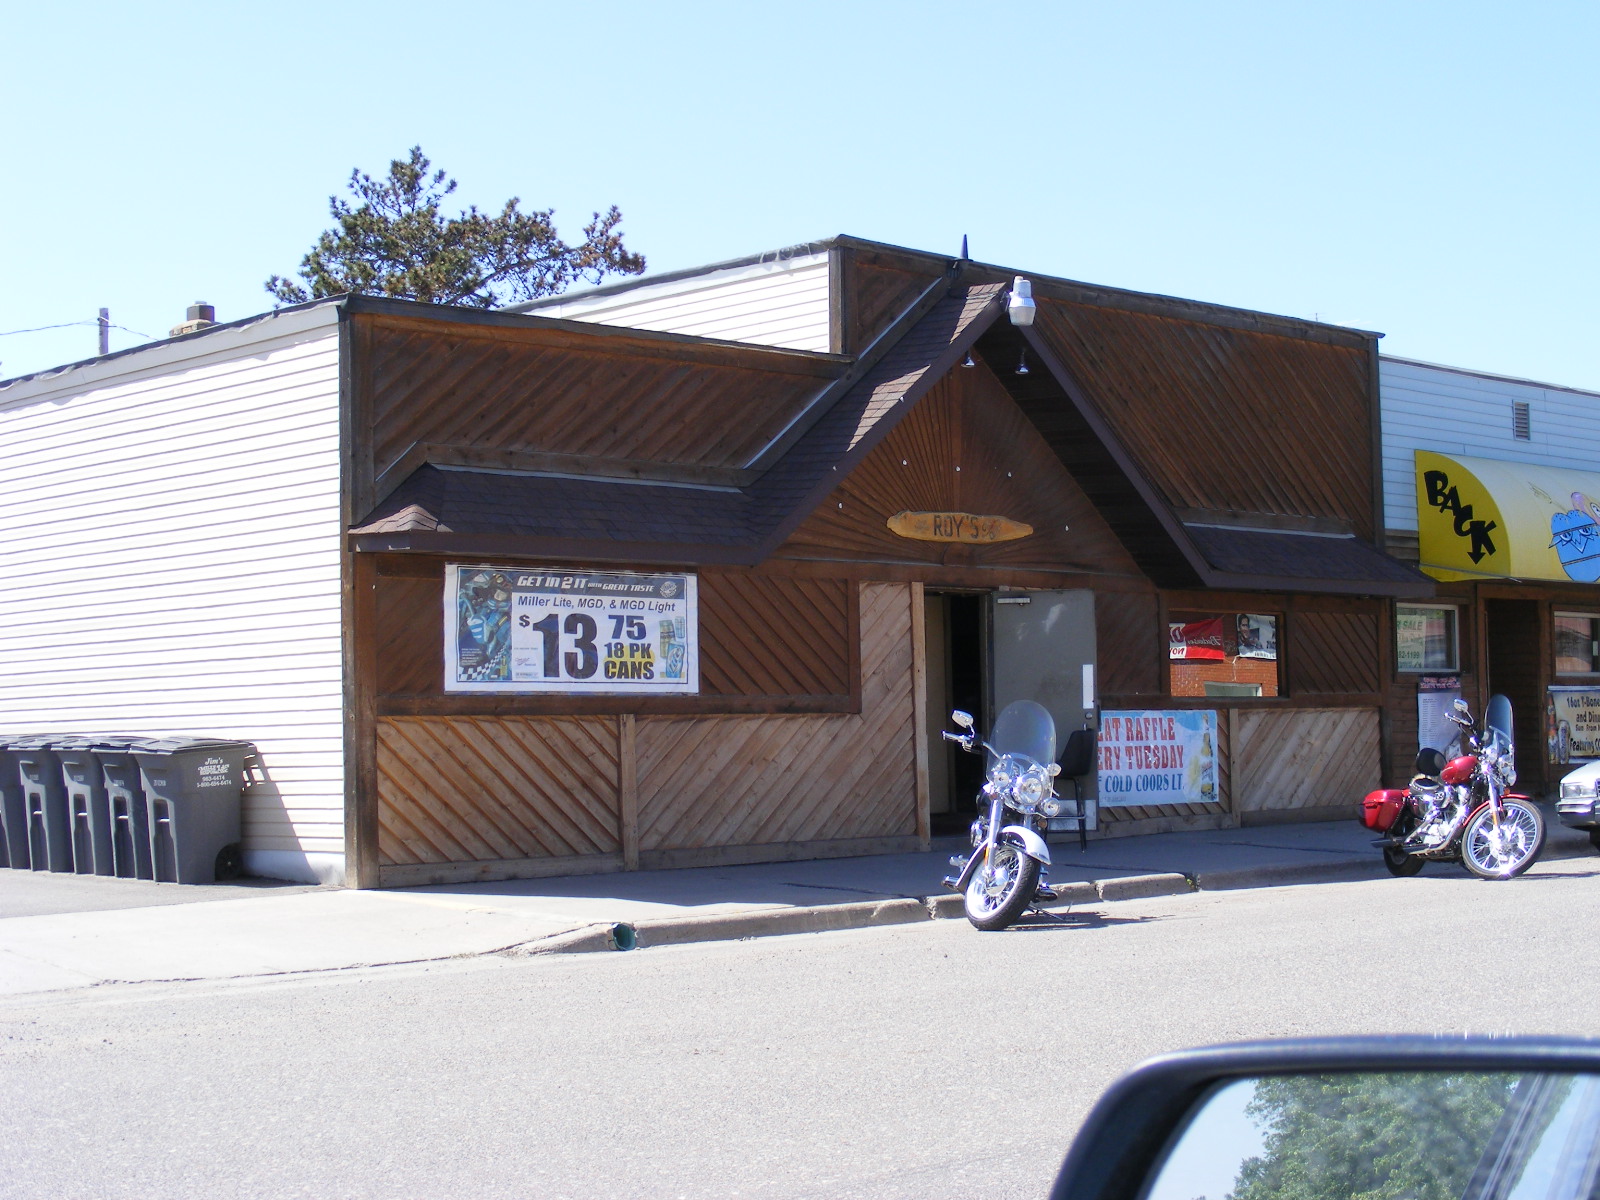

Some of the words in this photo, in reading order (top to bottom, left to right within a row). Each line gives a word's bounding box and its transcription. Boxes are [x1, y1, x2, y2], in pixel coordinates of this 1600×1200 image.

[933, 514, 979, 538] ROY'S
[1424, 470, 1497, 564] BACK
[517, 576, 544, 587] GET
[561, 576, 573, 589] 2
[573, 578, 588, 589] IT
[602, 583, 629, 591] GREAT
[630, 584, 655, 592] TASTE
[517, 595, 550, 607] Miller
[553, 596, 574, 609] Lite,
[577, 598, 606, 610] MGD,
[609, 600, 617, 609] &
[619, 600, 645, 610] MGD
[648, 601, 676, 613] Light
[608, 615, 647, 641] 75
[604, 642, 628, 658] 18
[632, 643, 652, 659] PK
[604, 661, 655, 680] CANS
[1125, 717, 1175, 741] RAFFLE
[1125, 745, 1184, 770] TUESDAY
[1105, 775, 1132, 793] COLD
[1136, 774, 1169, 791] COORS
